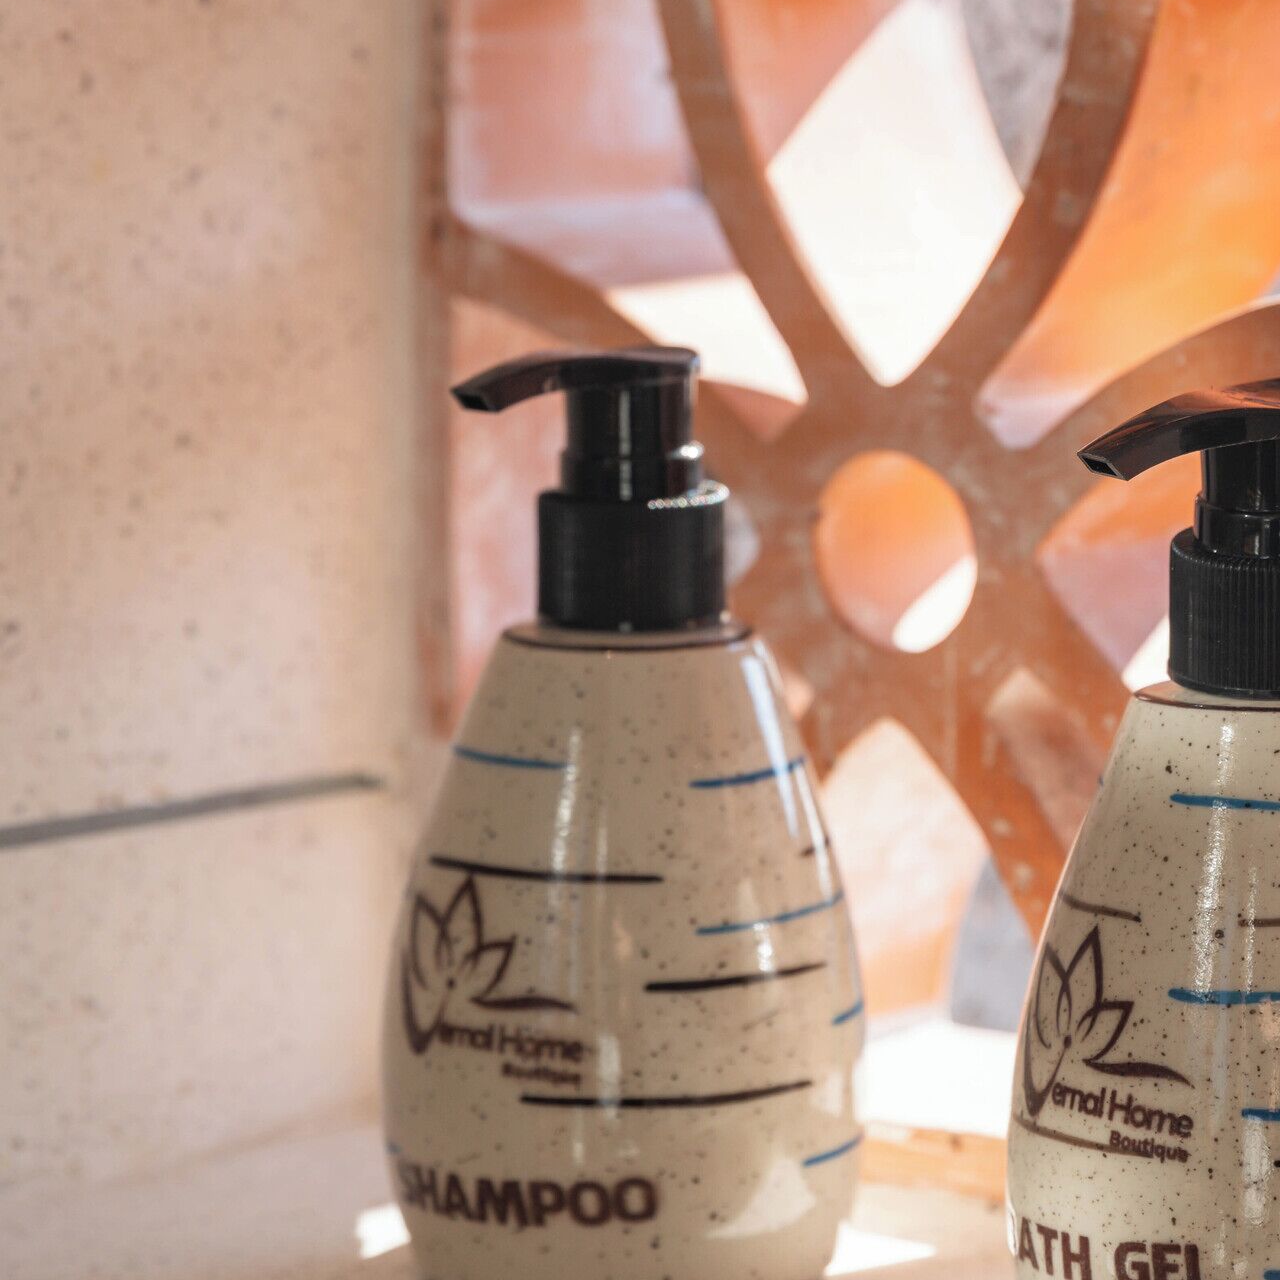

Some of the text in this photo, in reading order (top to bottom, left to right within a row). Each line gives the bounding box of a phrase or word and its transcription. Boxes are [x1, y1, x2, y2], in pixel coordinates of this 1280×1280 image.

[499, 1024, 583, 1063] Home
[1108, 1089, 1194, 1138] Home
[1109, 1130, 1192, 1164] Boutique
